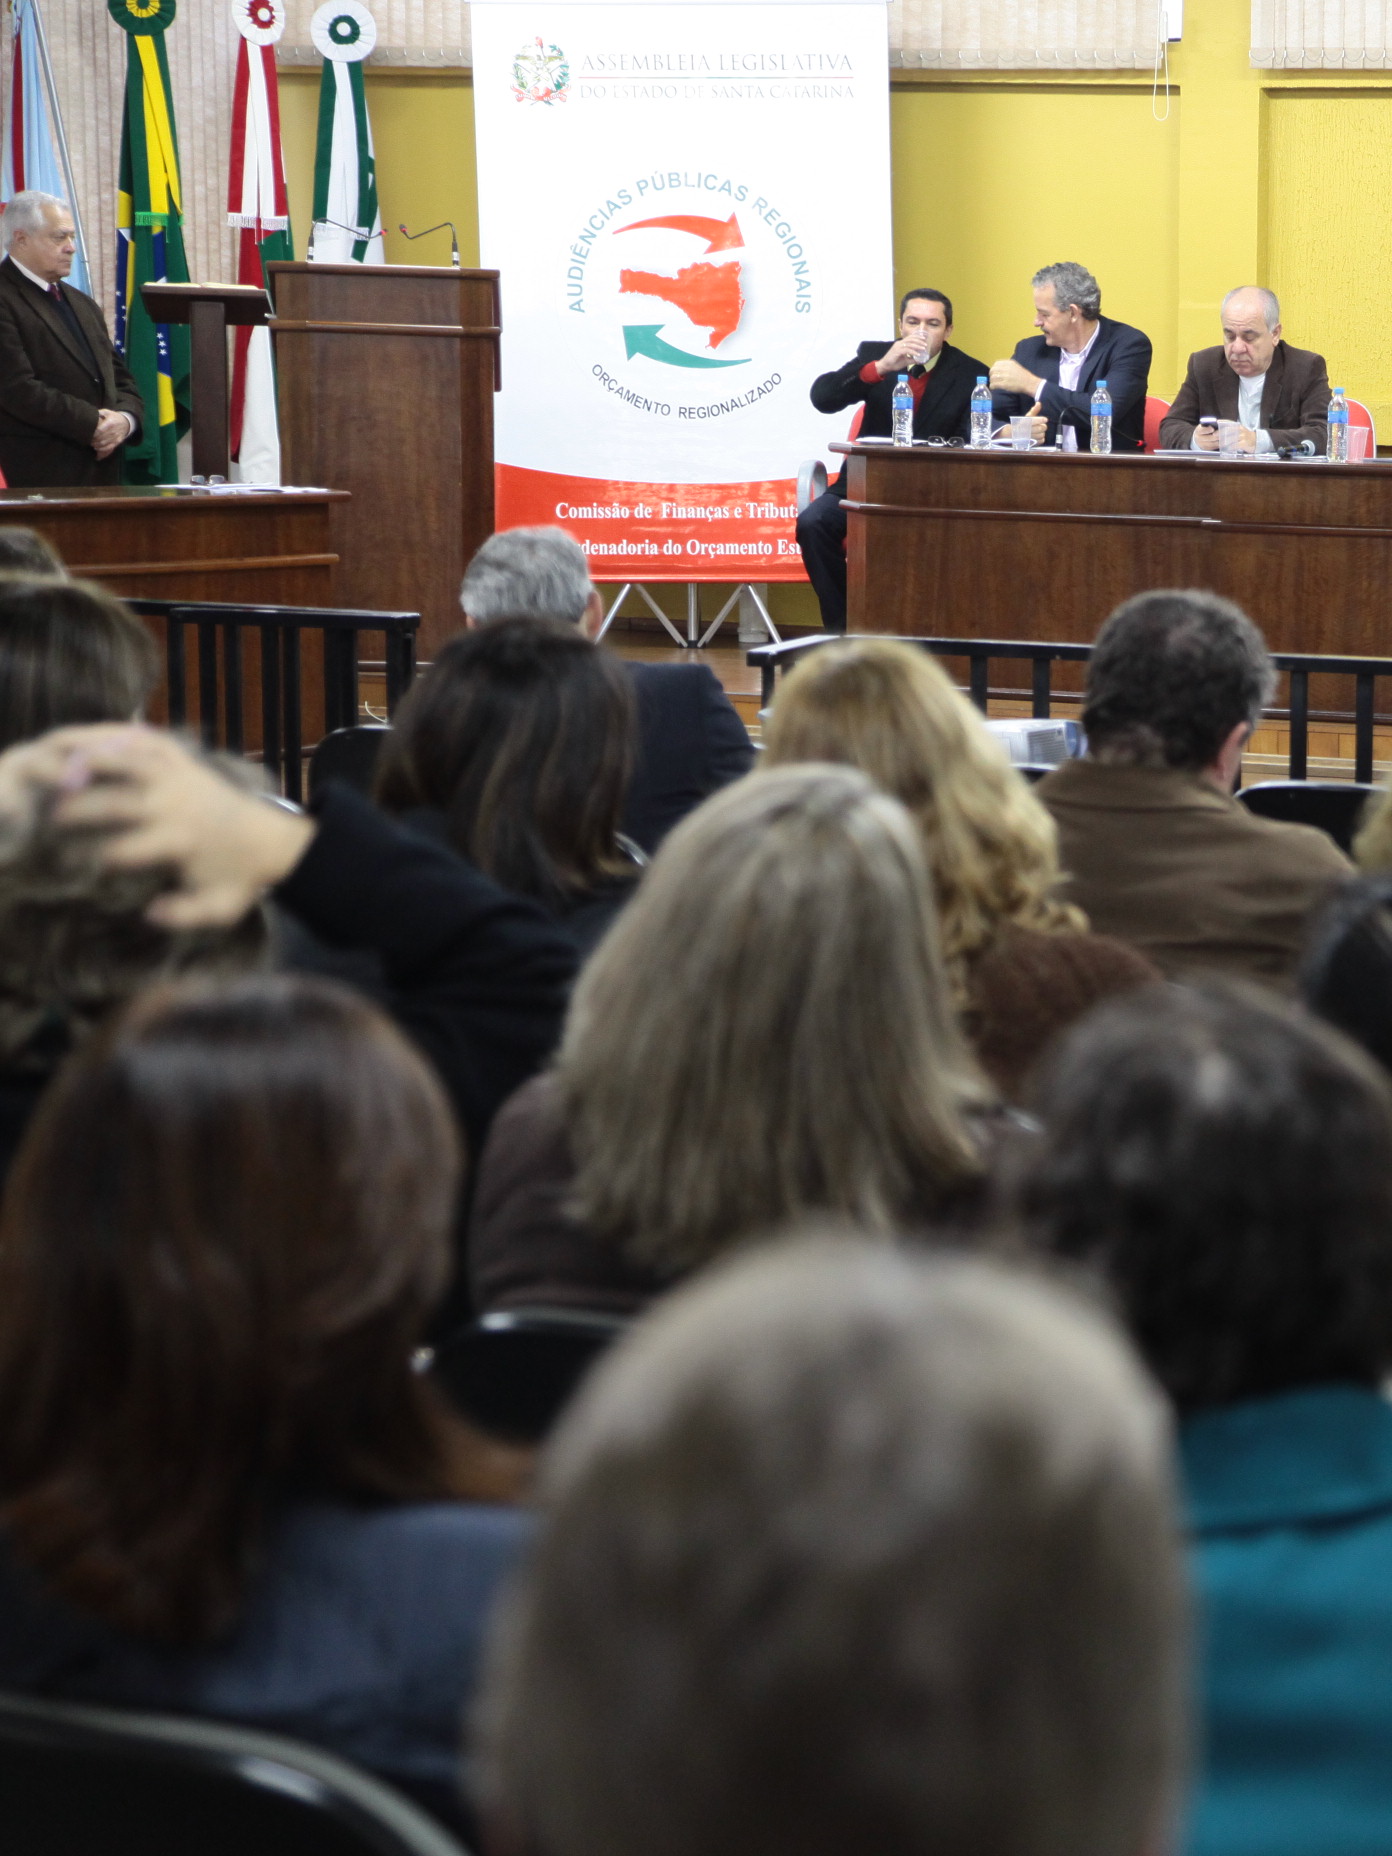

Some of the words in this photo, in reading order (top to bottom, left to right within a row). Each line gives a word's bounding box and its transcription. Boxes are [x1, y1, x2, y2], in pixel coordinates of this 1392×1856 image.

[581, 53, 711, 71] ASSEMBLEIA
[719, 53, 853, 71] LEGISLATIVA
[580, 85, 606, 99] DO
[613, 85, 678, 99] ESTADO
[684, 85, 705, 99] DE
[711, 85, 765, 99] SANTA
[769, 85, 855, 99] CATARINA
[568, 188, 633, 314] AUDIÊNCIAS
[636, 170, 749, 203] PÚBLICAS
[752, 196, 811, 315] REGIONAIS
[592, 364, 671, 416] ORÇAMENTO
[678, 372, 782, 420] REGIONALIZADO
[555, 502, 629, 519] Comissão
[634, 503, 652, 519] de
[662, 503, 730, 522] Finanças
[734, 507, 742, 519] e
[663, 539, 681, 555] do
[686, 539, 772, 559] Orçamento
